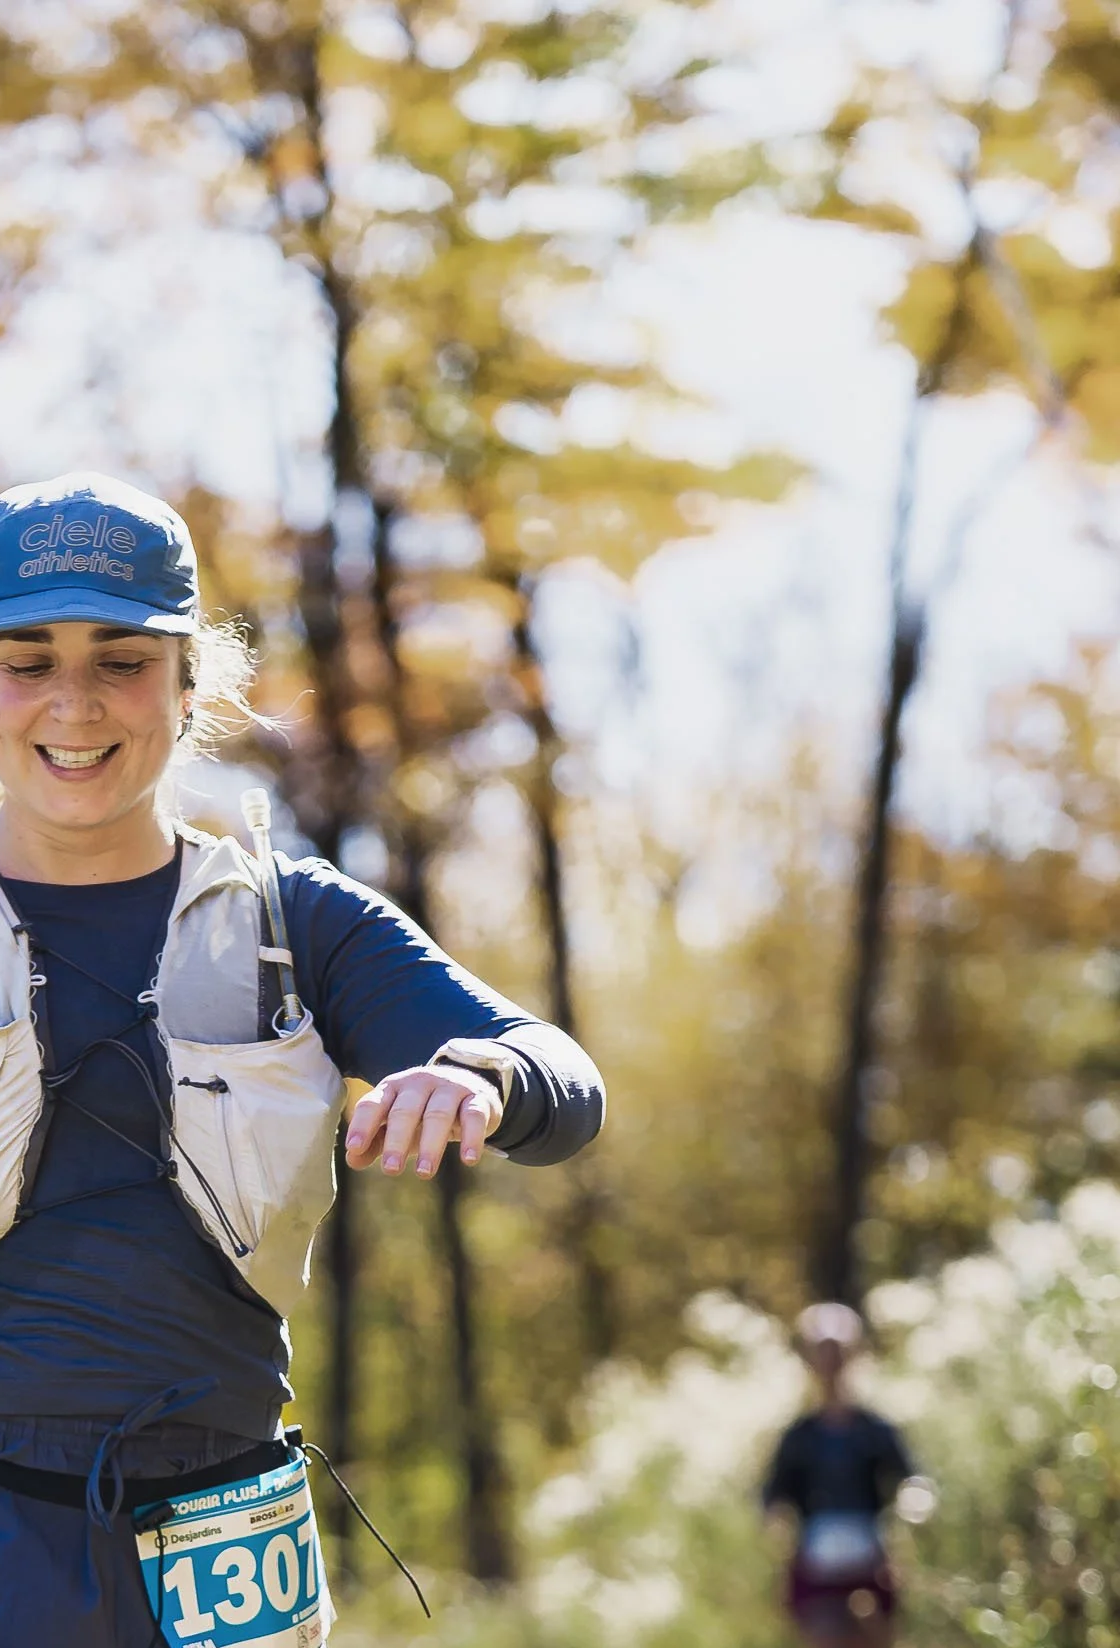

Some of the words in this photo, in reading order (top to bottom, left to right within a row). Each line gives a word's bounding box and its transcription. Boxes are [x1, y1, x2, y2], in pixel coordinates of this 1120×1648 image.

[19, 515, 137, 554] ciele
[18, 551, 136, 581] athletics
[172, 1494, 221, 1516] OURIR
[170, 1525, 222, 1546] Desjardins
[162, 1518, 318, 1639] 1307
